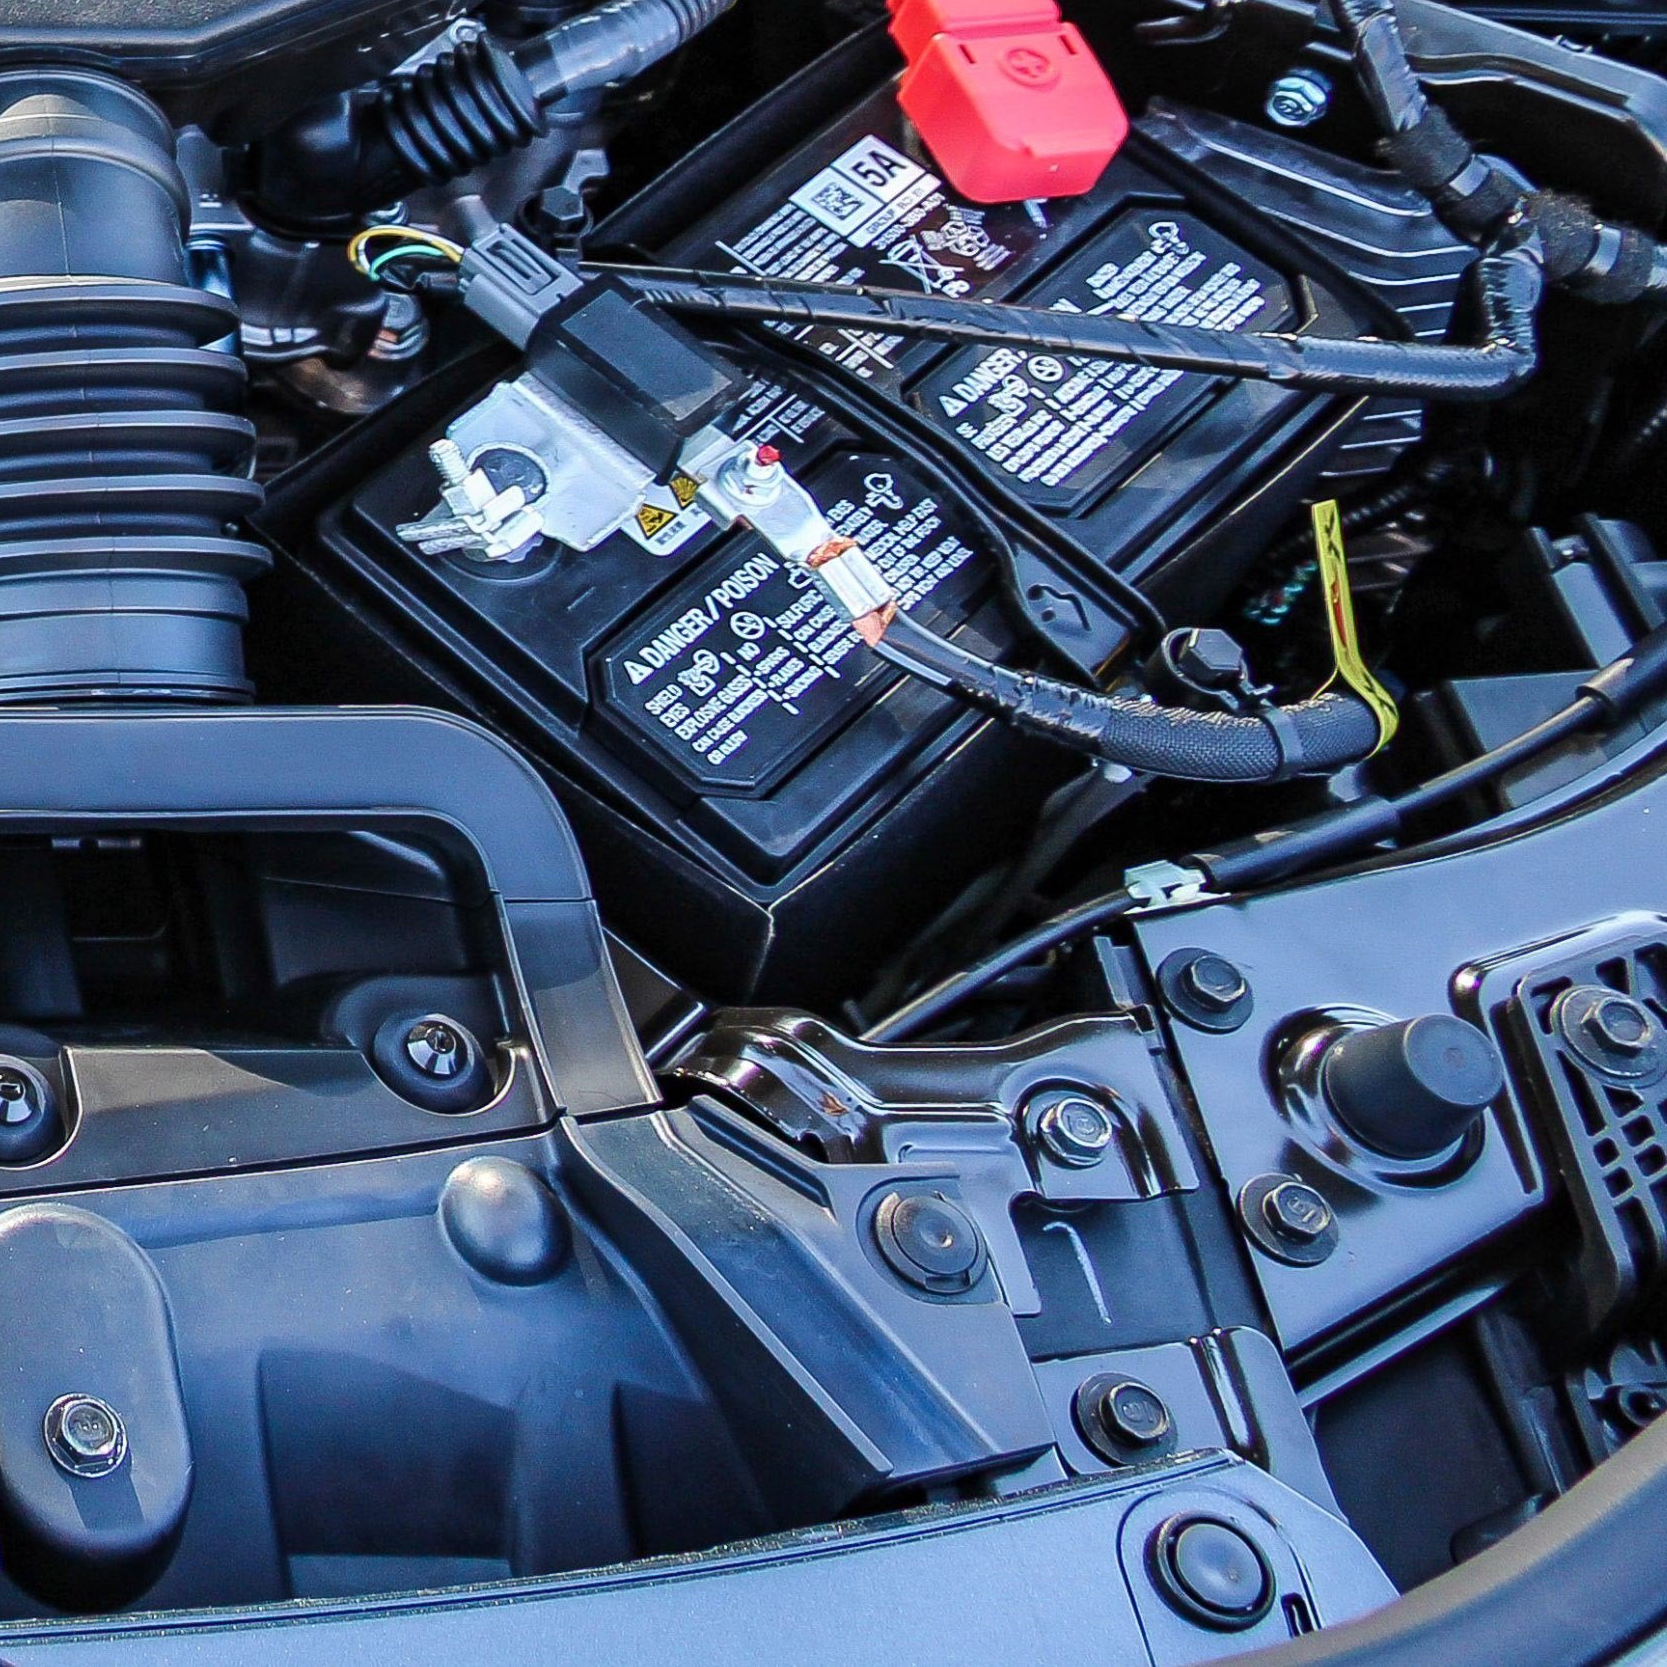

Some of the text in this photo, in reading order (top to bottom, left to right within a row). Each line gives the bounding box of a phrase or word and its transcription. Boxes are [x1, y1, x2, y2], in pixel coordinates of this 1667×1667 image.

[852, 150, 907, 188] 5A
[951, 344, 1022, 405] DANGER
[736, 639, 762, 662] NO
[643, 681, 685, 717] SHIELD
[658, 700, 692, 730] EYES
[673, 671, 753, 742] EXPLOSIVE GASES
